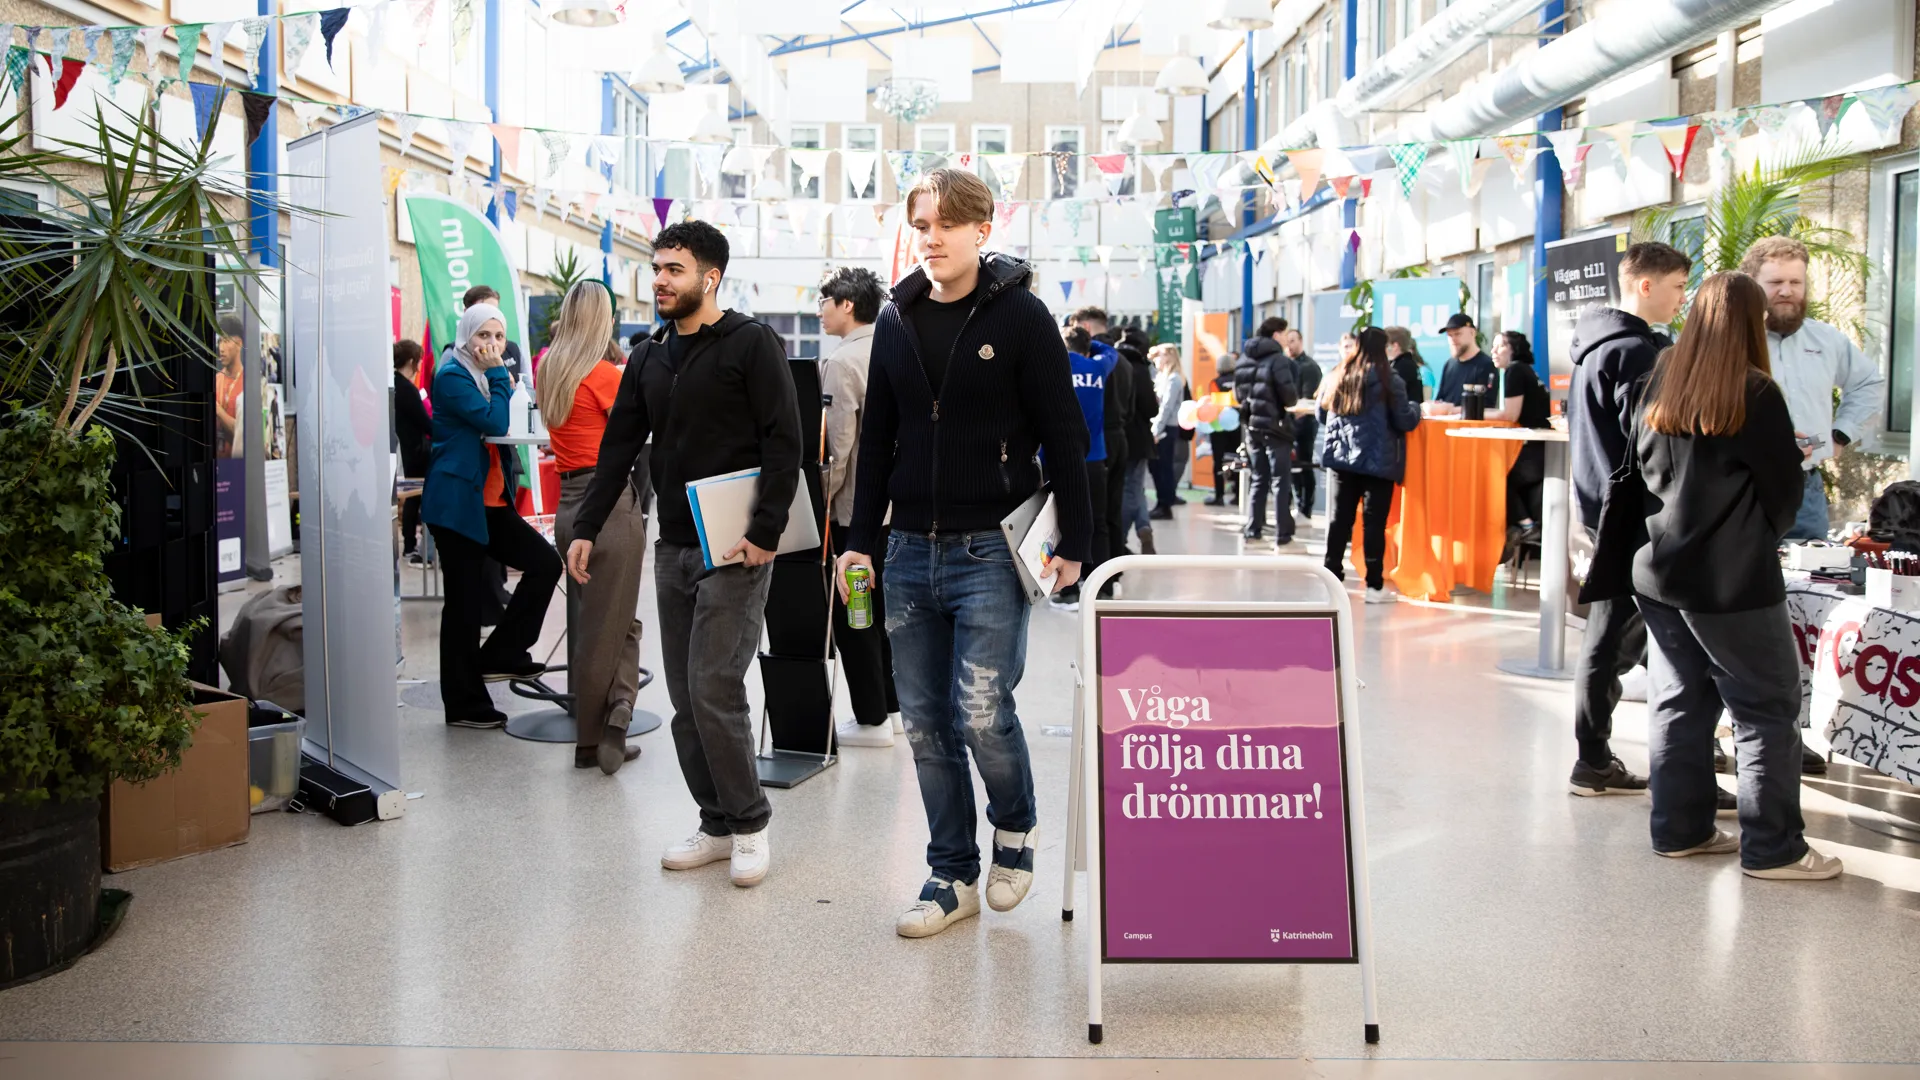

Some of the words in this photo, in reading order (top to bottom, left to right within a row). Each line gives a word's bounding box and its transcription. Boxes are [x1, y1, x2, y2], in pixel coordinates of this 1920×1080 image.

[1553, 268, 1581, 285] Vägen
[1583, 262, 1606, 278] till
[1554, 289, 1567, 303] en
[1569, 284, 1607, 301] hållbar
[1117, 684, 1212, 729] Våga
[1120, 733, 1206, 778] följa
[1215, 733, 1304, 771] dina
[1121, 782, 1324, 820] drömmar!
[1123, 931, 1153, 941] Campus
[1282, 930, 1334, 940] Katrineholm
